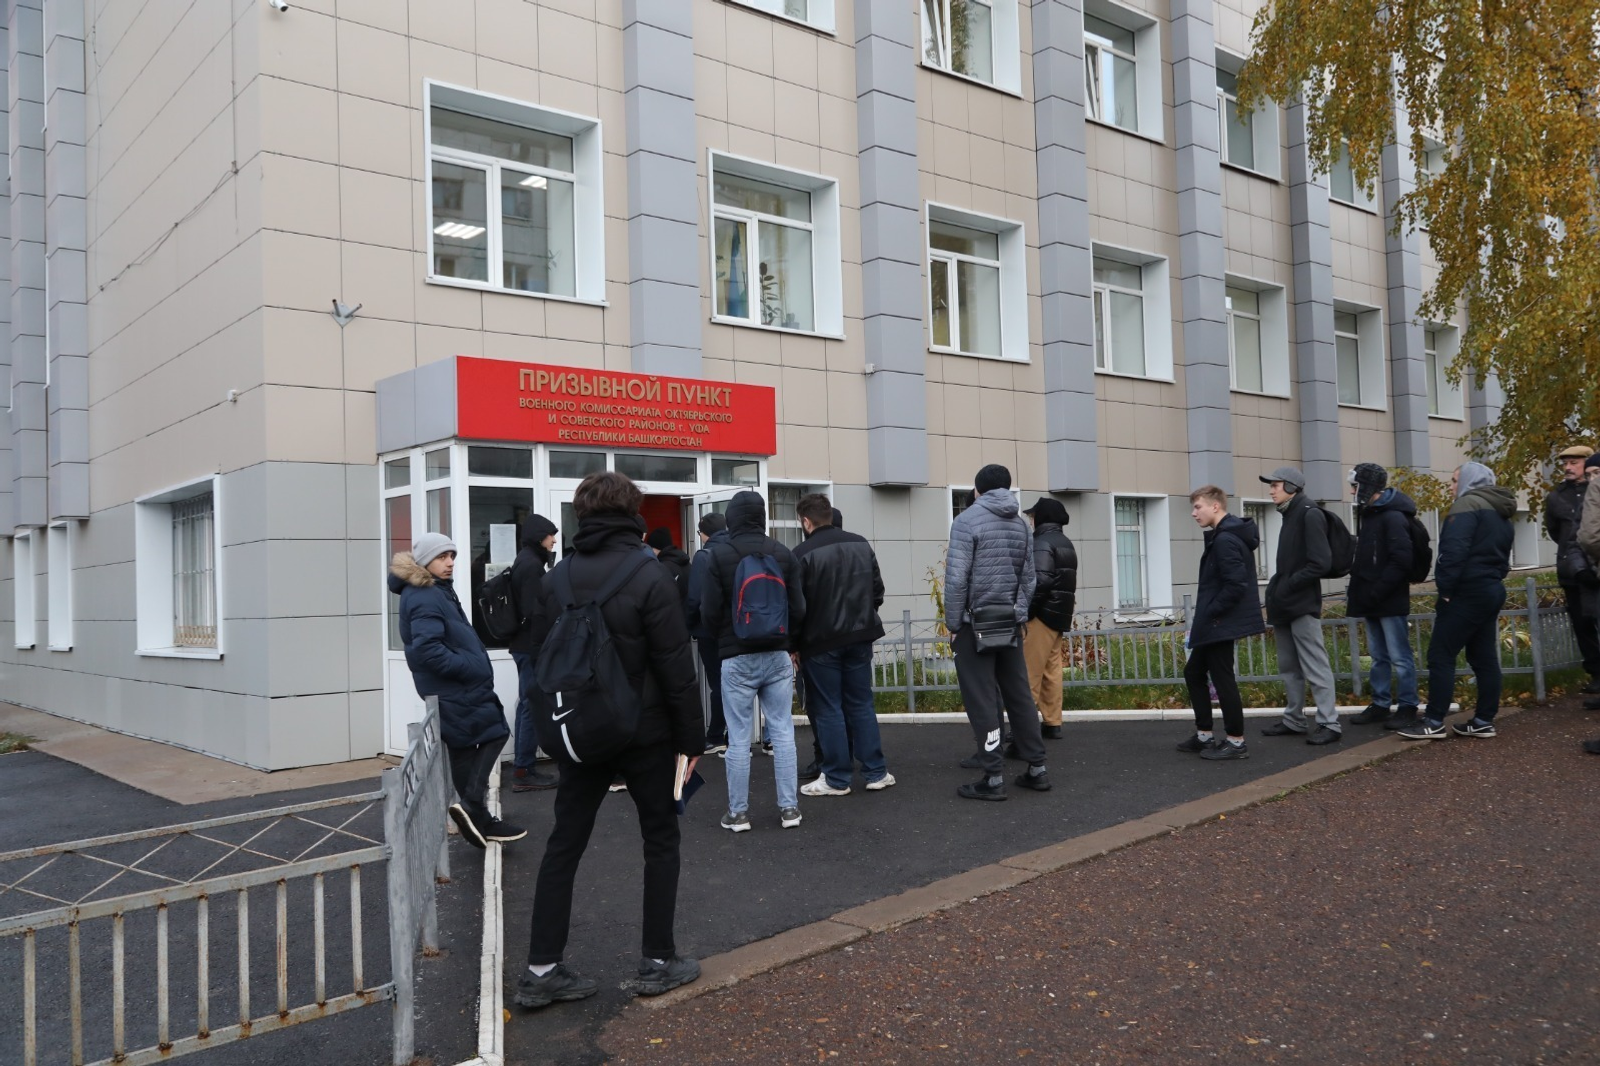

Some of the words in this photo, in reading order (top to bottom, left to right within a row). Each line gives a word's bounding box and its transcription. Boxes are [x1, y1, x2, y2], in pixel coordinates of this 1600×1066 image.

[519, 368, 661, 401] ПРИЗЫВНОЙ
[667, 382, 732, 408] ПУНКТ
[519, 397, 576, 412] ВОЕННОГО
[580, 402, 661, 418] КОМИССАРИАТА
[665, 408, 733, 423] ОКТЯБРЬСКОГО
[548, 413, 557, 424] И
[560, 414, 626, 429] СОВЕТСКОГО
[629, 419, 676, 432] РАЙОНОВ
[689, 423, 710, 434] УФА
[558, 428, 626, 443] РЕСПУБЛИКИ
[628, 433, 703, 447] БАШКОРТОСТАН
